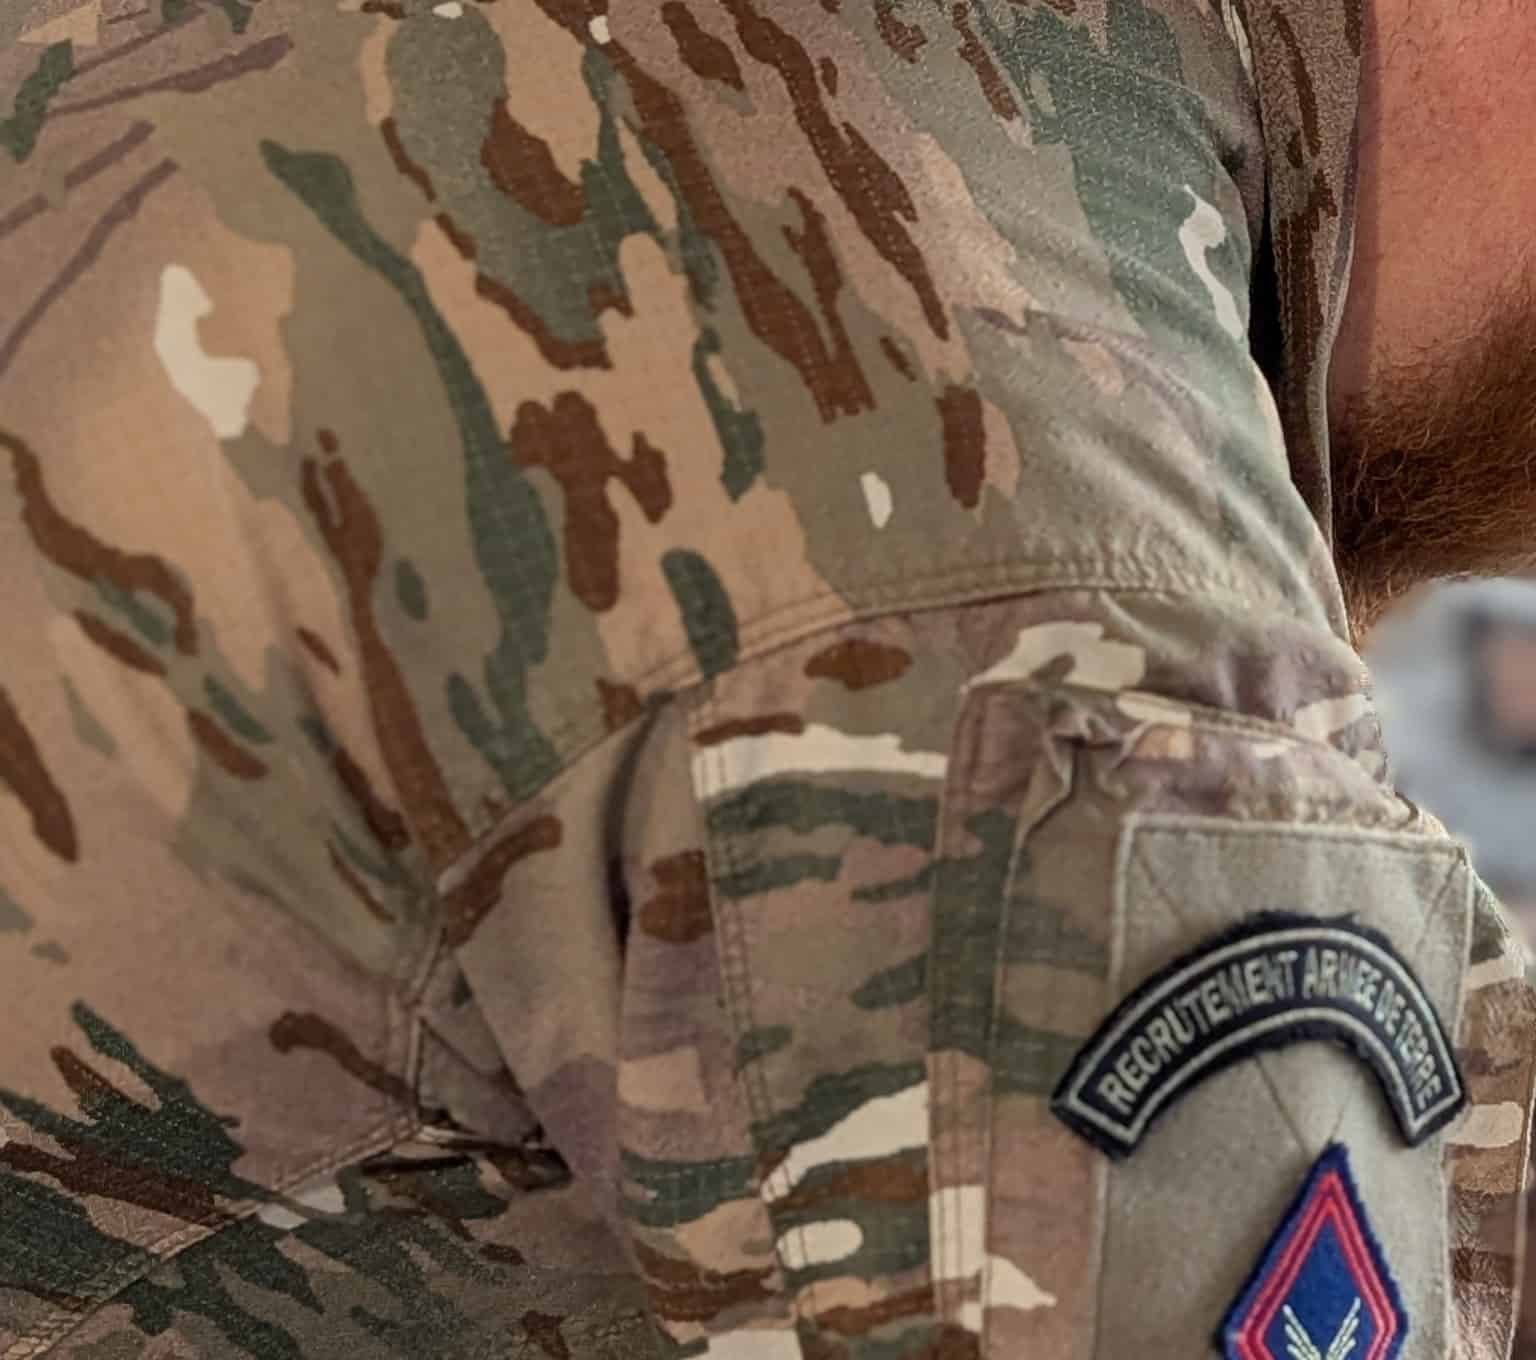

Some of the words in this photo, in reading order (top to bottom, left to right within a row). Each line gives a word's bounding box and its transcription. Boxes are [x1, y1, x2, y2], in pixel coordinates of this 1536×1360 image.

[1098, 950, 1299, 1116] RECRUTEMENT
[1374, 978, 1406, 1036] DE
[1393, 1009, 1442, 1111] TERRE
